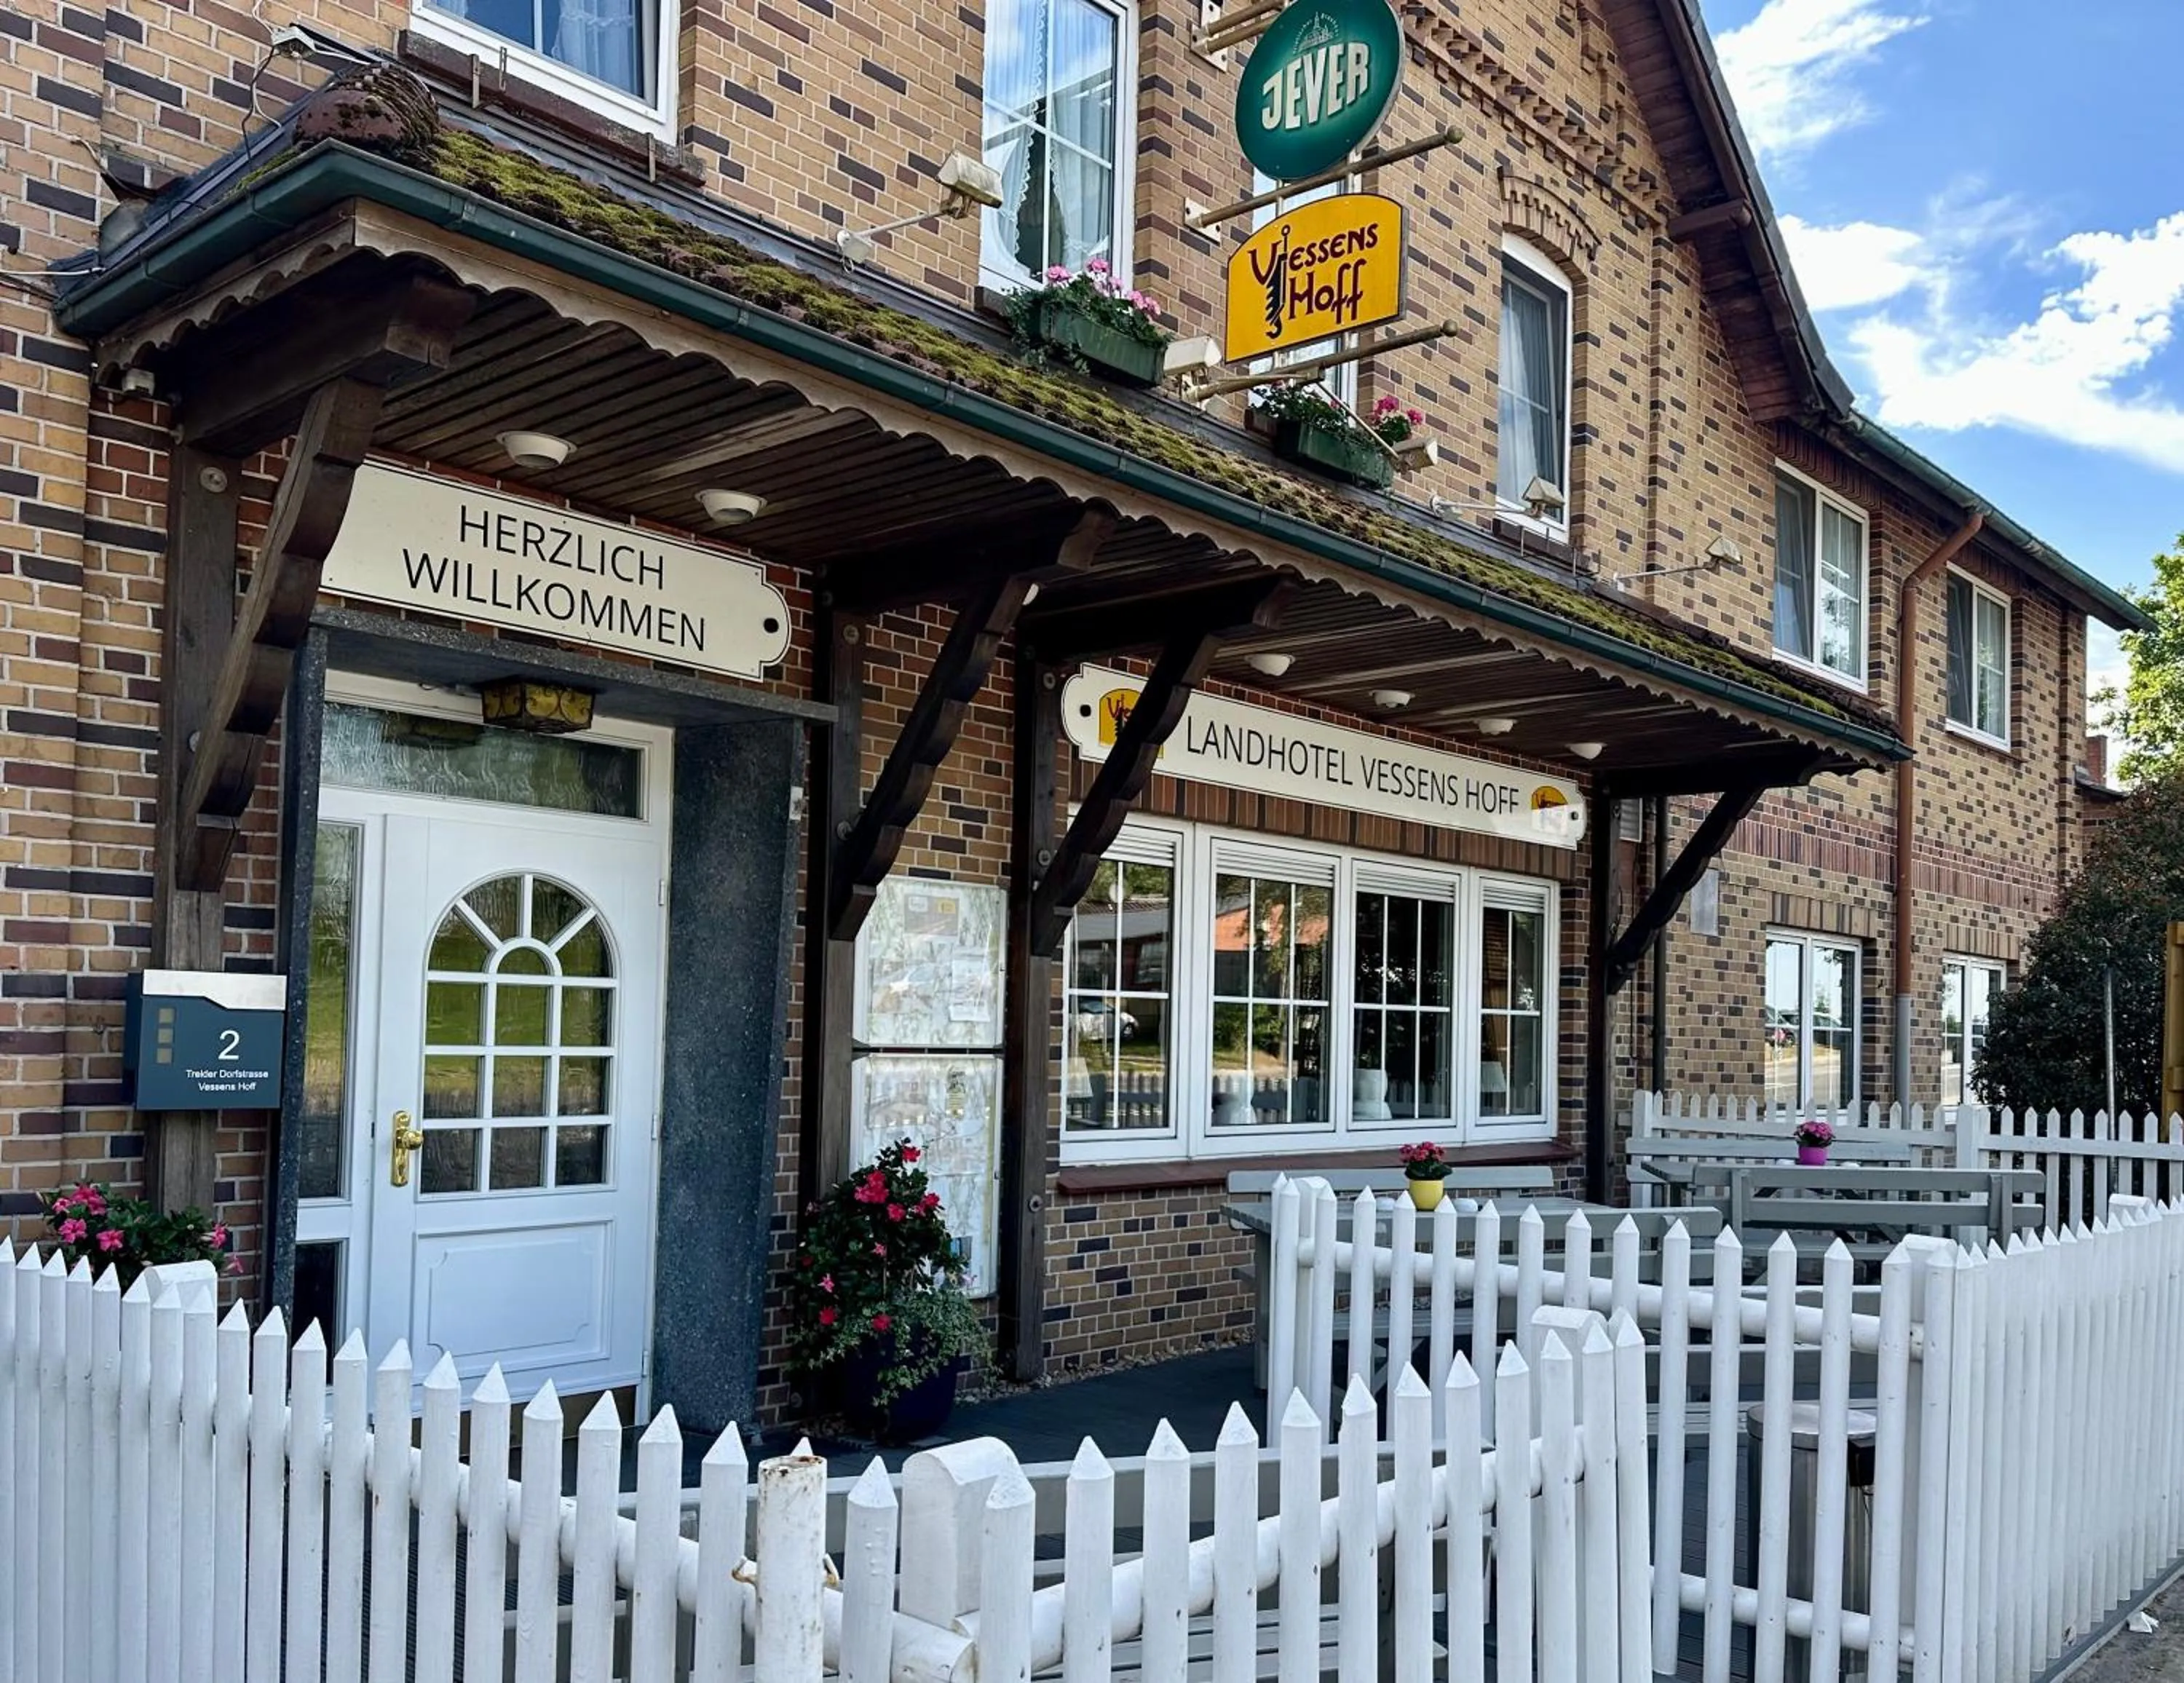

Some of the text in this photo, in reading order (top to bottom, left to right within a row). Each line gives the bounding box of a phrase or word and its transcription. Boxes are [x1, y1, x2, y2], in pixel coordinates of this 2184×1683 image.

[1262, 42, 1369, 130] JEVER
[1289, 258, 1366, 325] Hoff
[459, 505, 664, 590] HERZLICH
[403, 548, 705, 652] WILLKOMMEN
[1187, 716, 1519, 815] LANDHOTEL VESSENS HOFF
[198, 1082, 257, 1091] Vessens Hoff
[218, 1029, 240, 1061] 2
